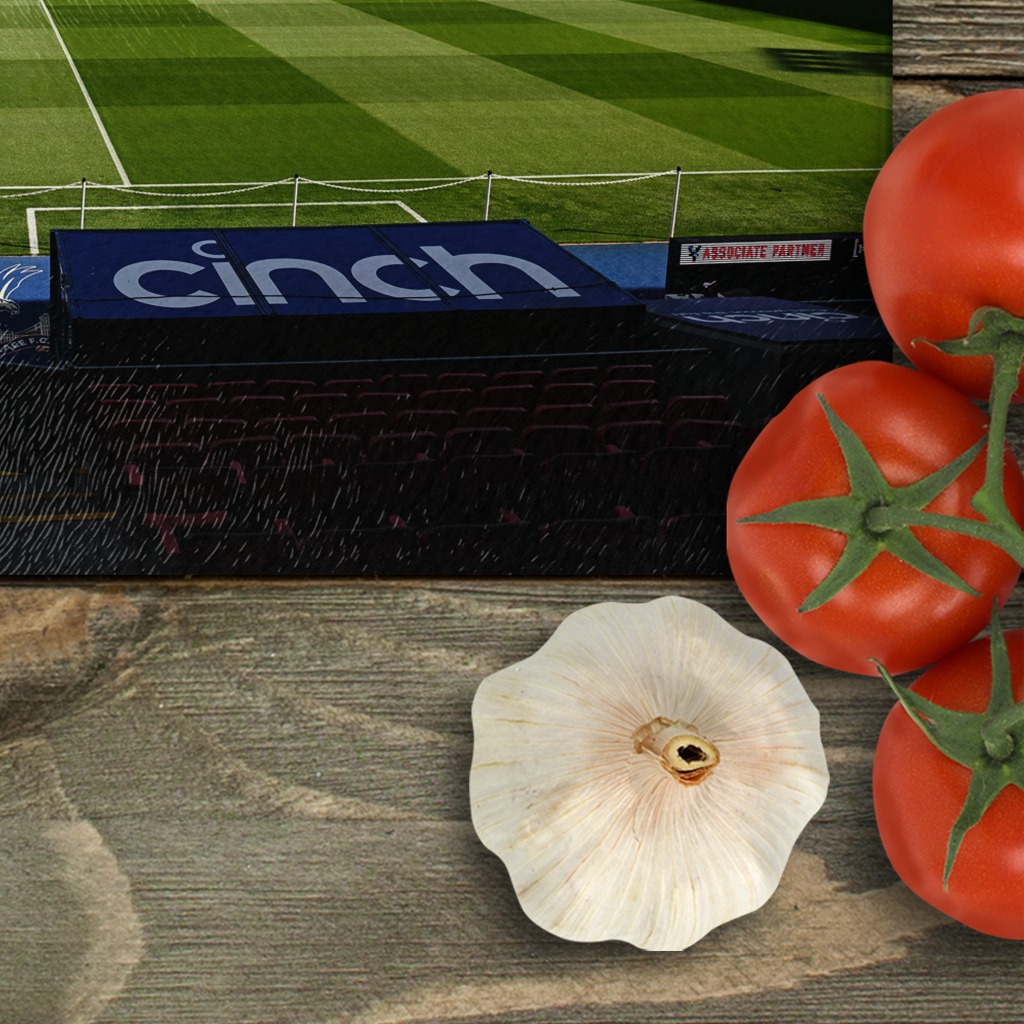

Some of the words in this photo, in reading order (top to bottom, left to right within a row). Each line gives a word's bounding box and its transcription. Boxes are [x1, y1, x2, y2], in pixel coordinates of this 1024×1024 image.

[703, 245, 768, 260] ASSOCIATE
[772, 243, 825, 258] PARTNER
[113, 240, 581, 308] cinch
